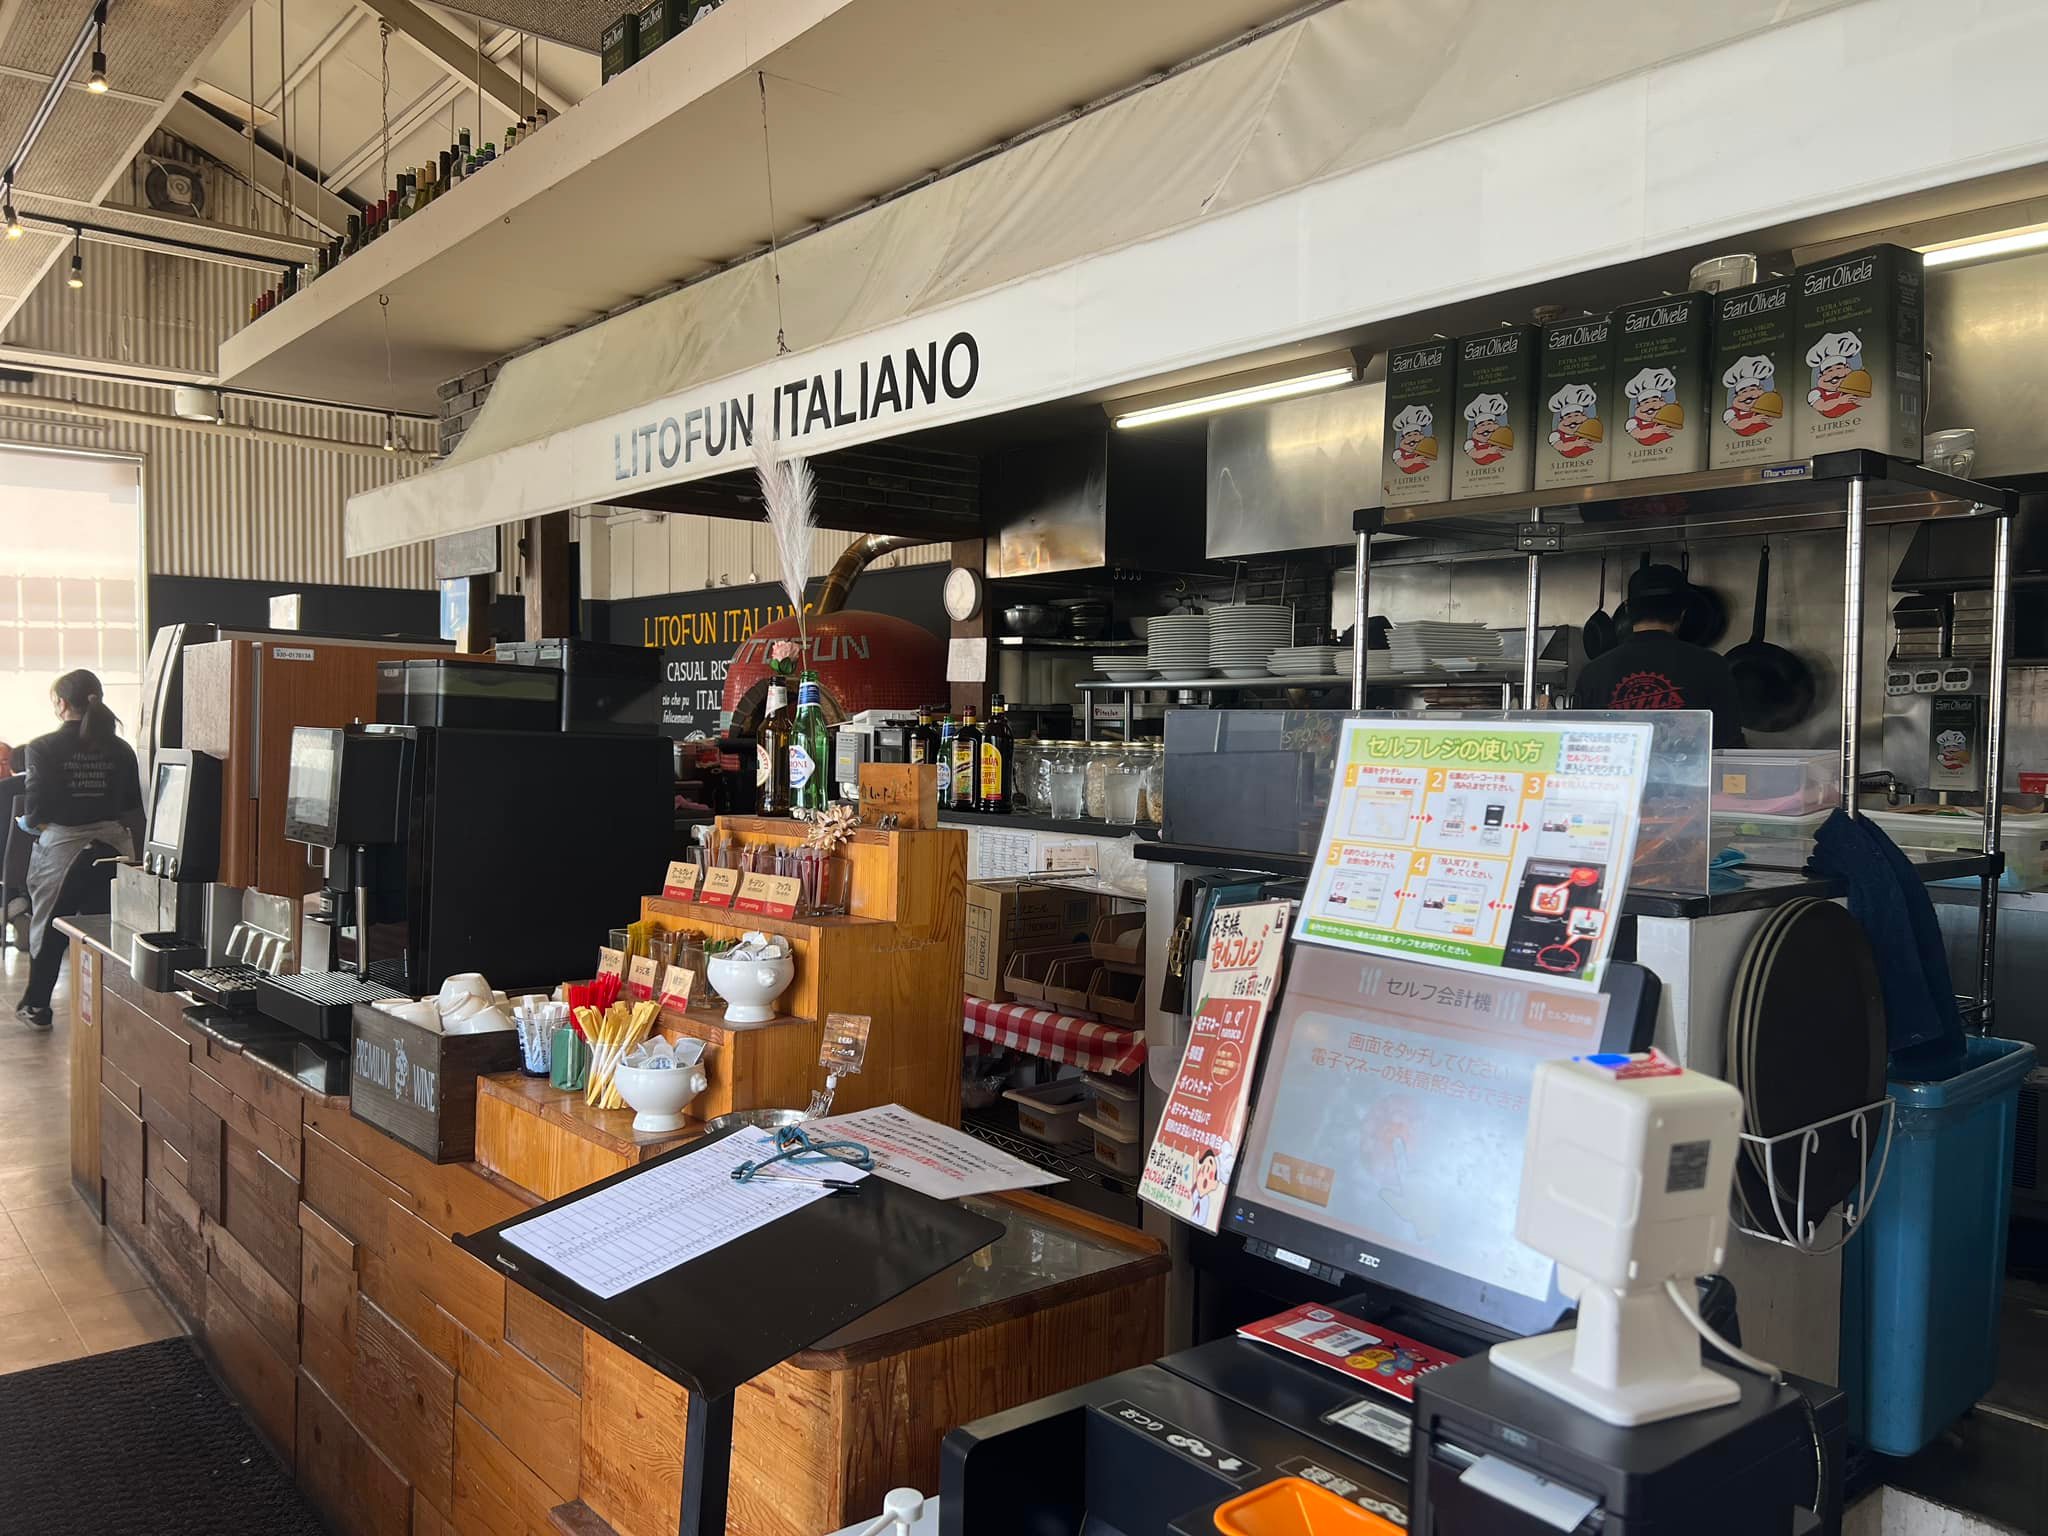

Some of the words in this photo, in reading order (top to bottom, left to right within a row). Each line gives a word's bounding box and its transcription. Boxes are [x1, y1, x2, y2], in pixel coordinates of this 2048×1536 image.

[1804, 275, 1831, 295] San
[1722, 301, 1748, 319] San
[1625, 313, 1650, 331] San
[1549, 331, 1573, 349] San
[1464, 342, 1487, 360] San
[615, 393, 754, 481] LITOFUN
[773, 332, 980, 441] ITALIANO
[1763, 467, 1804, 479] Maruzen
[643, 612, 718, 648] LITOFUN
[667, 660, 708, 682] CASUAL
[1367, 735, 1544, 763] セルフレジの使い方
[1346, 766, 1354, 784] 1
[1432, 772, 1442, 788] 2
[1528, 777, 1540, 793] 3
[1329, 848, 1338, 861] 5
[1414, 856, 1425, 872] 4
[1211, 923, 1270, 969] セルフレジ
[1386, 977, 1493, 1013] セルフ会計機
[355, 1037, 391, 1091] PREMIUM
[1349, 1031, 1510, 1081] 画面をタッチしてください
[412, 1062, 436, 1114] WINE
[1358, 1252, 1382, 1268] TEC
[1119, 1407, 1164, 1433] おつり
